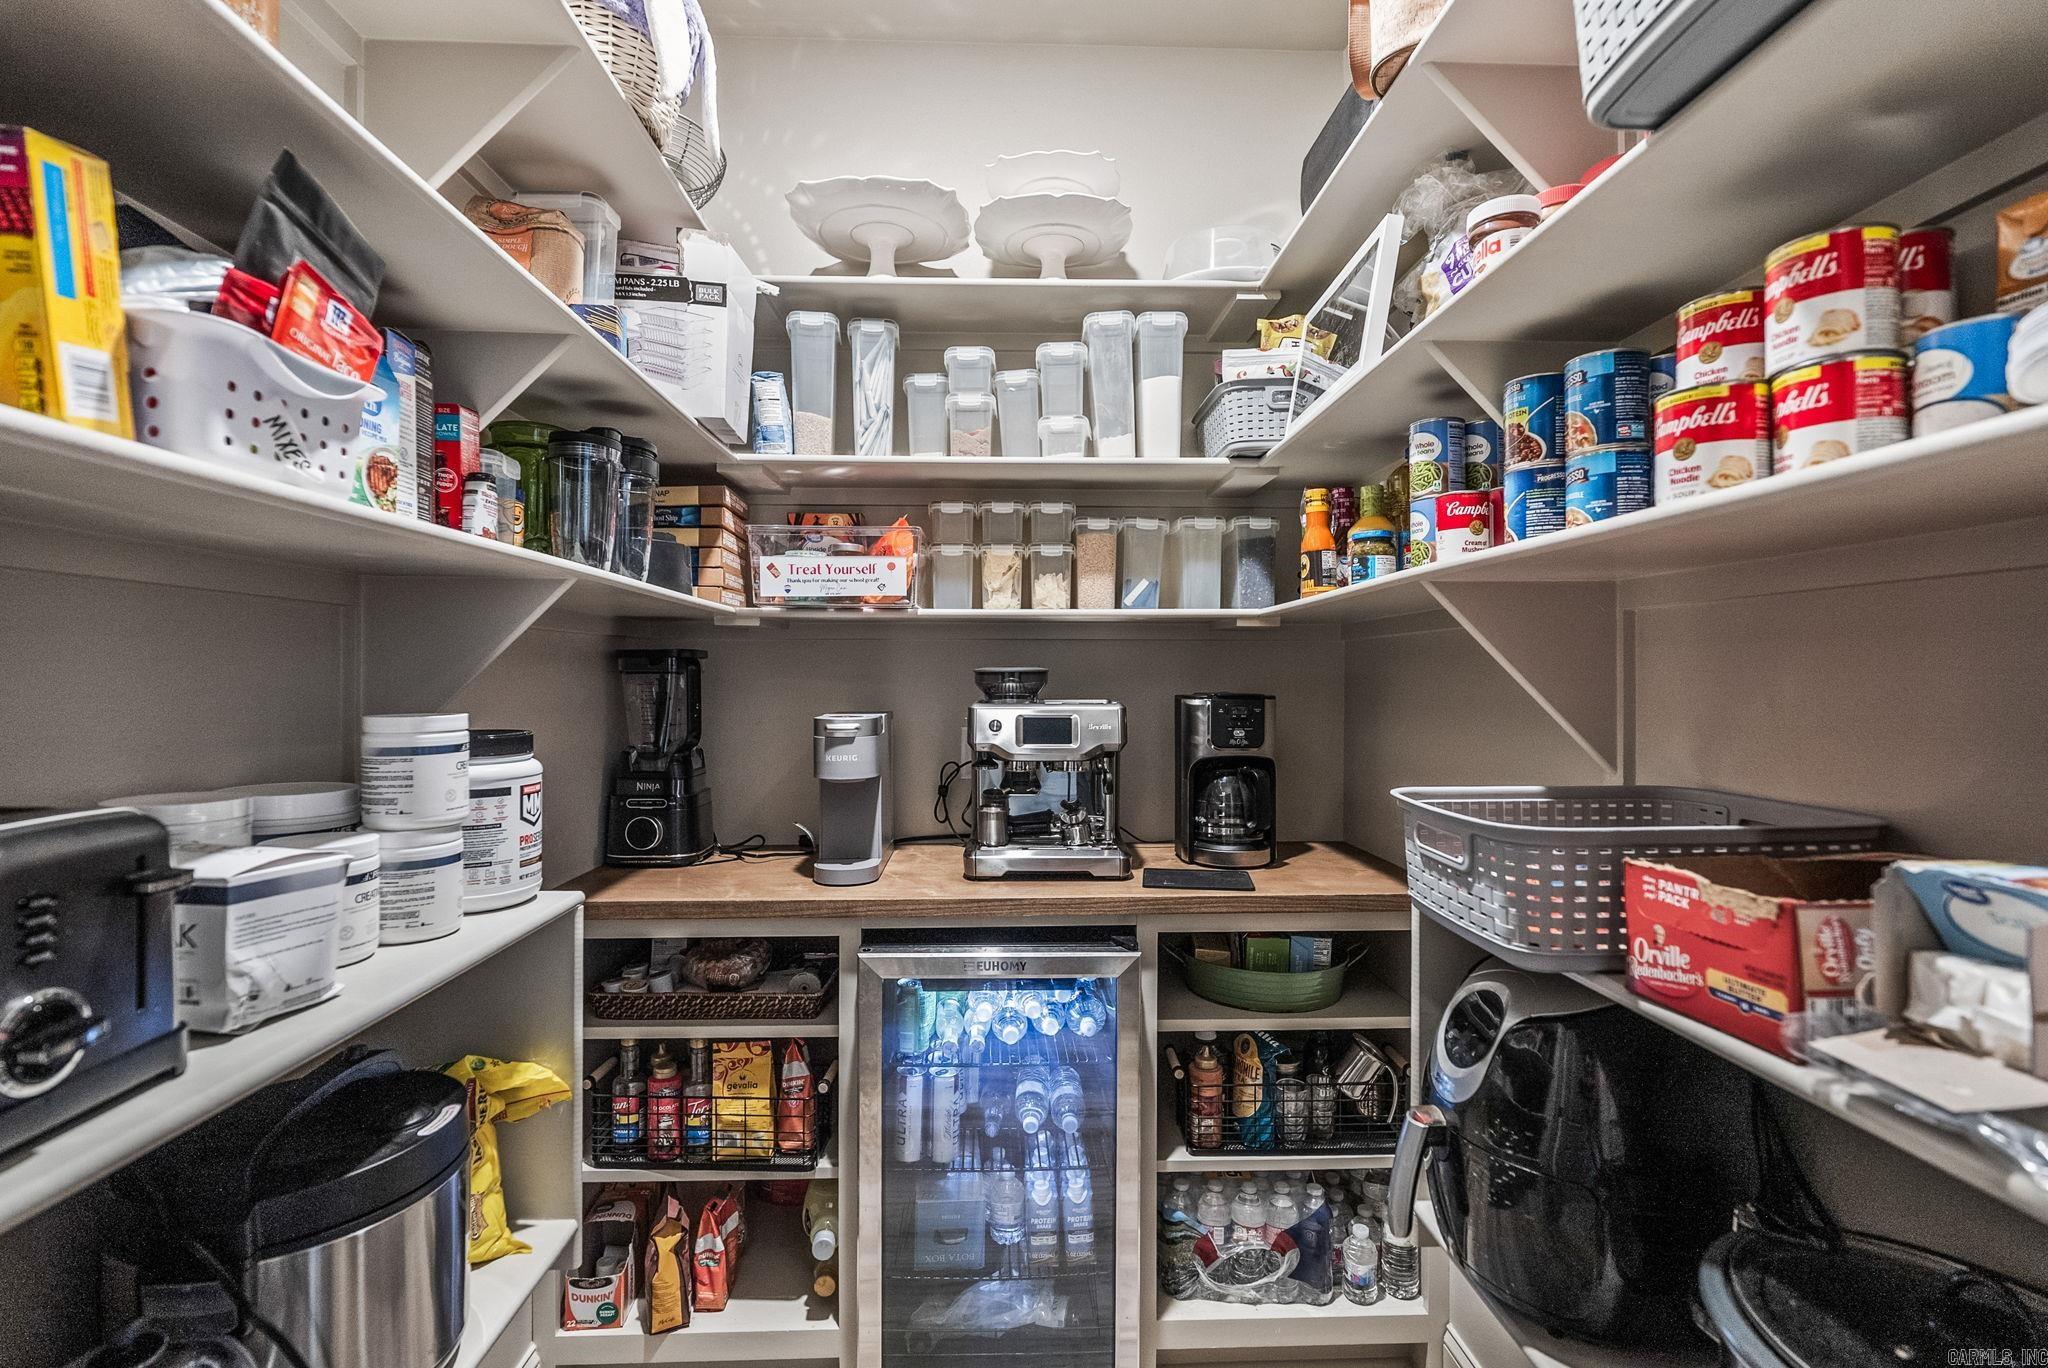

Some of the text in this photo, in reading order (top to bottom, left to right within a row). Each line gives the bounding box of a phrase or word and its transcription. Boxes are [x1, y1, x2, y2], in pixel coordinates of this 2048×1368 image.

[623, 278, 646, 286] PANS
[650, 278, 668, 287] 2.25
[668, 279, 680, 288] LB
[698, 287, 720, 295] BULK
[698, 293, 721, 301] PACK
[262, 414, 312, 469] MIXES
[787, 562, 878, 575] Treat Yourself
[825, 754, 858, 762] KEURIG
[636, 781, 661, 792] NINJA
[1657, 890, 1690, 910] PACK
[1633, 936, 1691, 970] Orville
[976, 960, 1027, 972] EUHOMY
[1628, 955, 1705, 988] Redenbacher's
[896, 1098, 908, 1146] ULTRA
[1067, 1214, 1094, 1223] PROTEIN
[570, 1289, 614, 1304] DUNKIN'
[565, 1319, 577, 1328] 22
